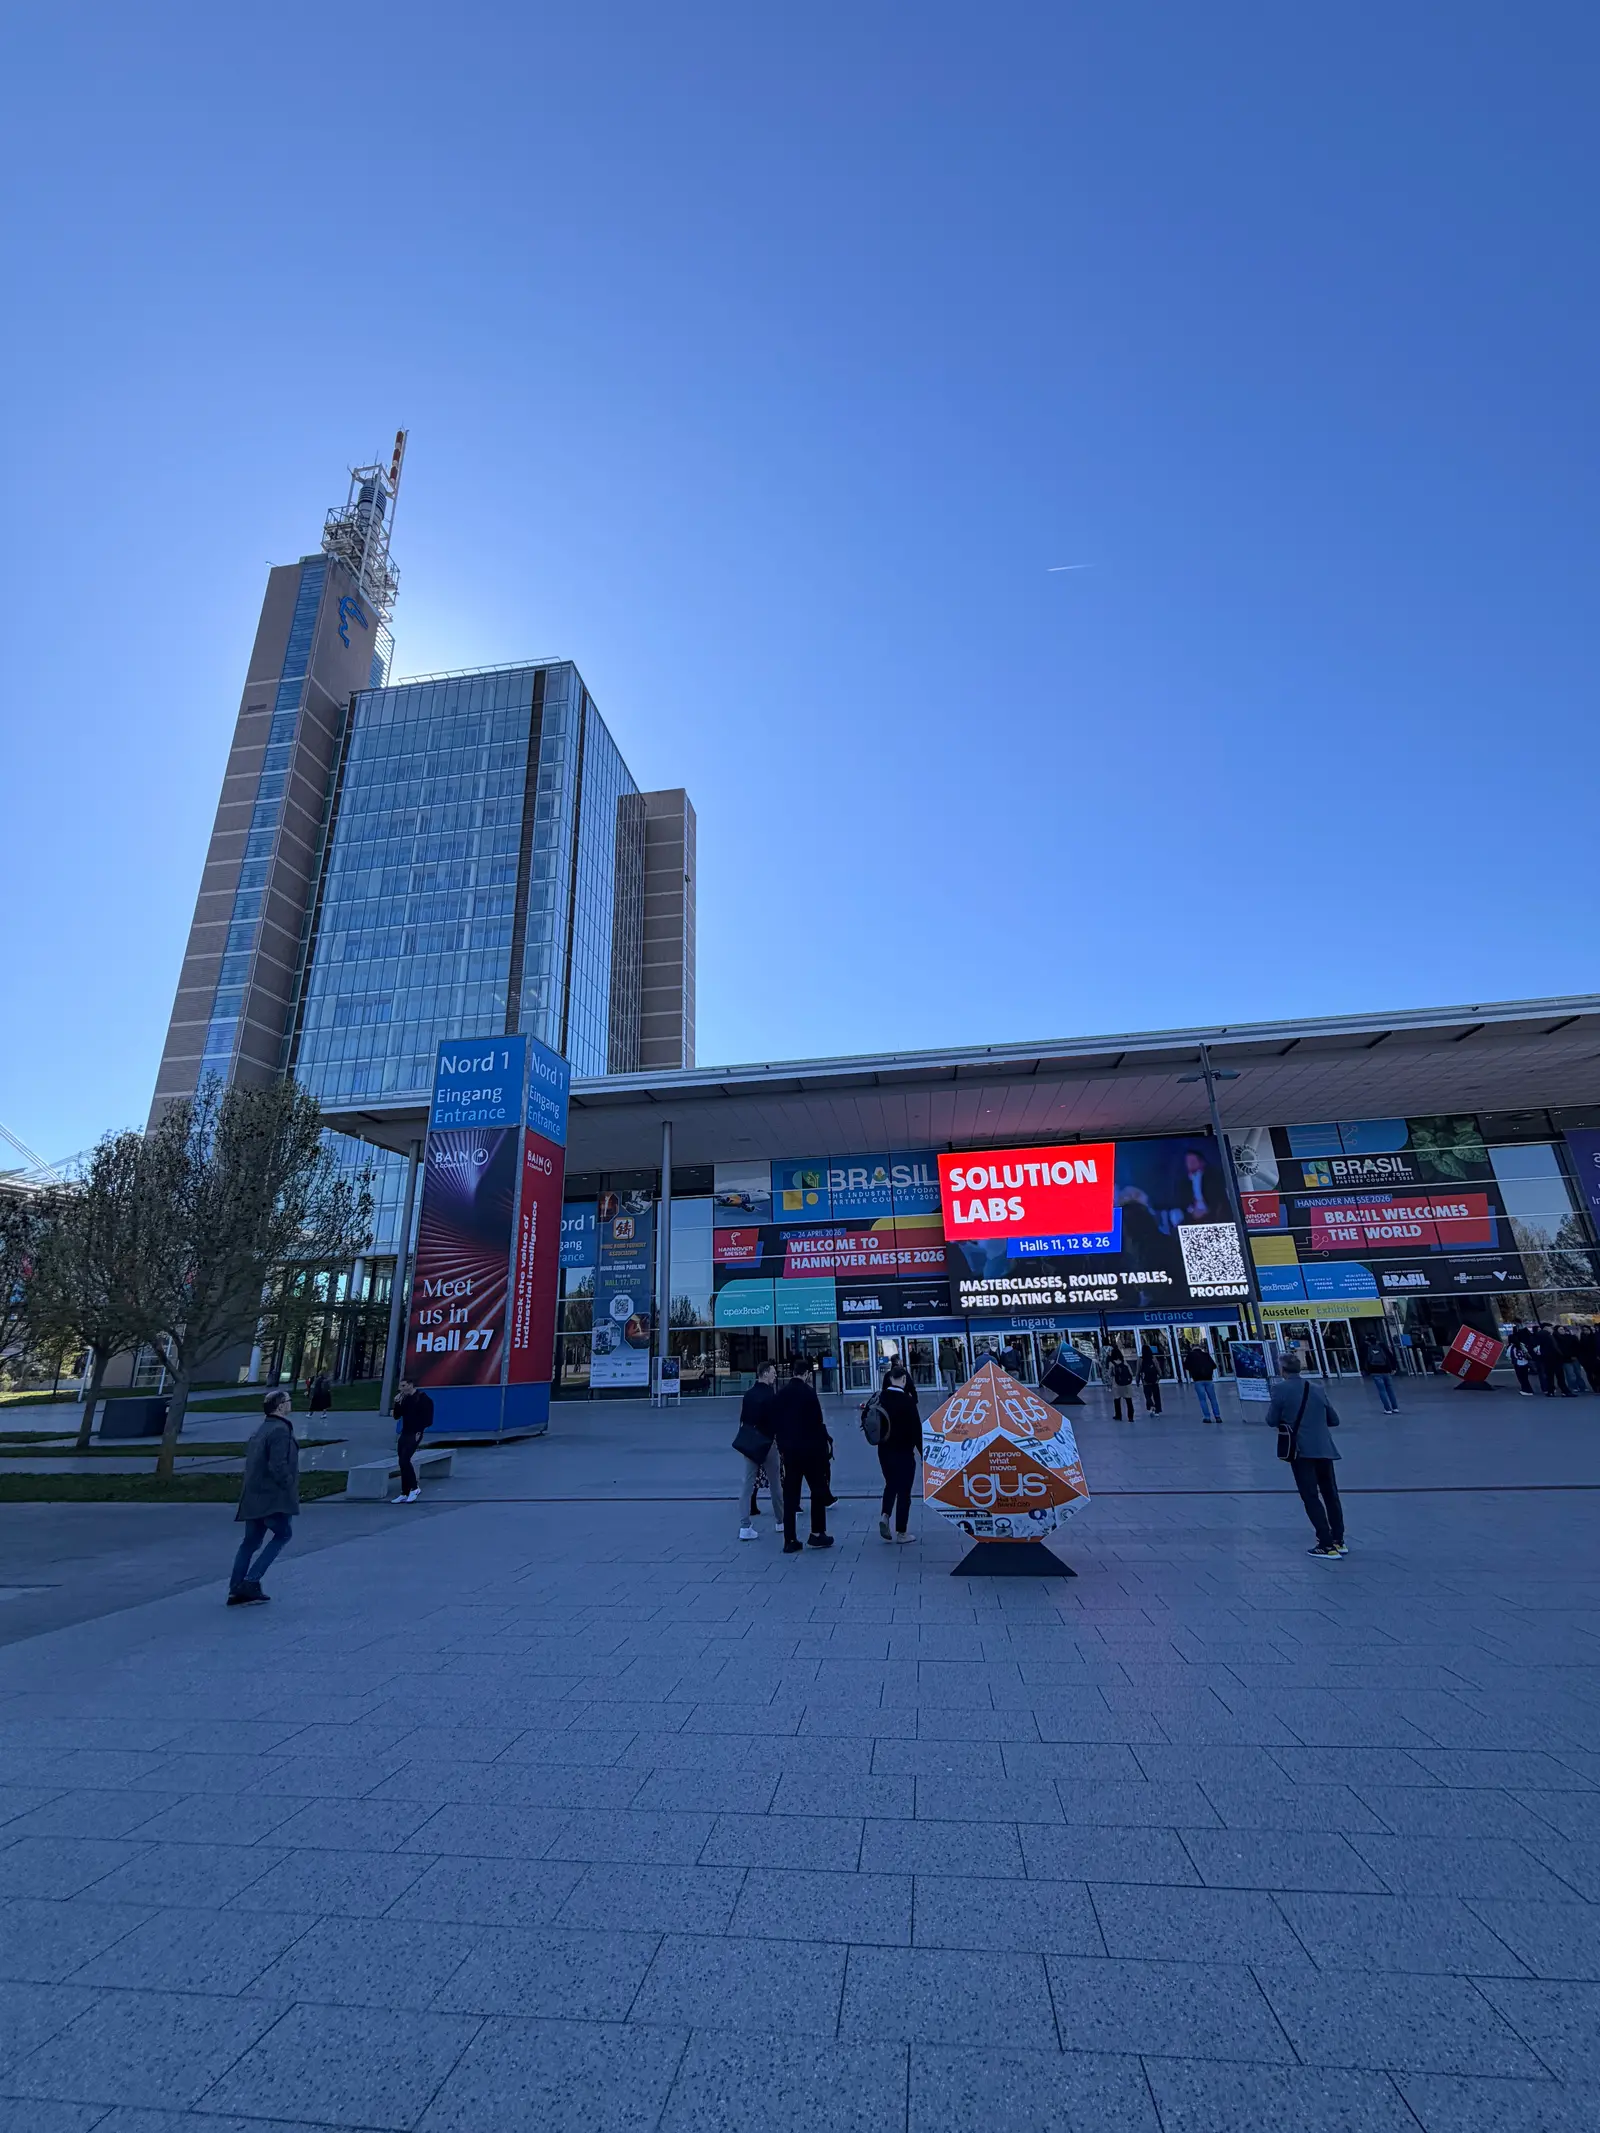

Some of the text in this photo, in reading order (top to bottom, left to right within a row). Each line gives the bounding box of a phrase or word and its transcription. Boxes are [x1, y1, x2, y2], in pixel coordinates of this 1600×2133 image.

[440, 1051, 509, 1075] Nord 1
[531, 1052, 563, 1090] Nord 1
[437, 1087, 503, 1106] Eingang
[529, 1085, 560, 1119] Eingang
[435, 1108, 506, 1123] Entrance
[528, 1105, 561, 1136] Entrance
[435, 1150, 469, 1163] BAIN
[527, 1150, 544, 1167] BAIN
[949, 1160, 1098, 1192] SOLUTION
[1331, 1157, 1412, 1176] BRASIL
[827, 1163, 940, 1192] BRASIL
[828, 1198, 867, 1206] PARTNER
[872, 1195, 915, 1203] COUNTRY
[848, 1189, 892, 1198] INDUSTRY
[913, 1186, 938, 1194] TODAY
[1297, 1194, 1391, 1207] HANNOVER MESSE 2026
[952, 1196, 1025, 1224] LABS
[1324, 1204, 1469, 1224] BRAZIL WELCOMES
[561, 1214, 596, 1232] ord 1
[798, 1230, 806, 1238] 24
[806, 1229, 825, 1237] APRIL
[825, 1228, 842, 1236] 2026
[1328, 1225, 1422, 1241] THE WORLD
[560, 1239, 583, 1250] gang
[789, 1237, 879, 1253] WELCOME TO
[1019, 1236, 1110, 1252] Halls 11, 12 & 26
[791, 1250, 945, 1269] HANNOVER MESSE 2026
[514, 1214, 530, 1349] Unlock the value of
[522, 1201, 538, 1348] Industrial intelligence
[959, 1271, 1173, 1292] MASTERCLASSES, ROUND TABLES,
[1382, 1273, 1431, 1287] BRASIL
[421, 1278, 475, 1298] Meet
[842, 1299, 883, 1312] BRASIL
[960, 1289, 1118, 1308] SPEED DATING & STAGES
[419, 1303, 469, 1325] us in
[723, 1306, 765, 1317] apexBrasil
[1144, 1310, 1194, 1321] Entrance
[1262, 1305, 1361, 1317] Aussteller Exhibitor
[879, 1322, 925, 1333] Entrance
[1011, 1317, 1056, 1329] Eingang
[415, 1329, 495, 1353] Hall 27
[942, 1392, 991, 1433] igus
[996, 1395, 1048, 1435] igus
[988, 1450, 1021, 1459] improve
[960, 1468, 1048, 1508] igus
